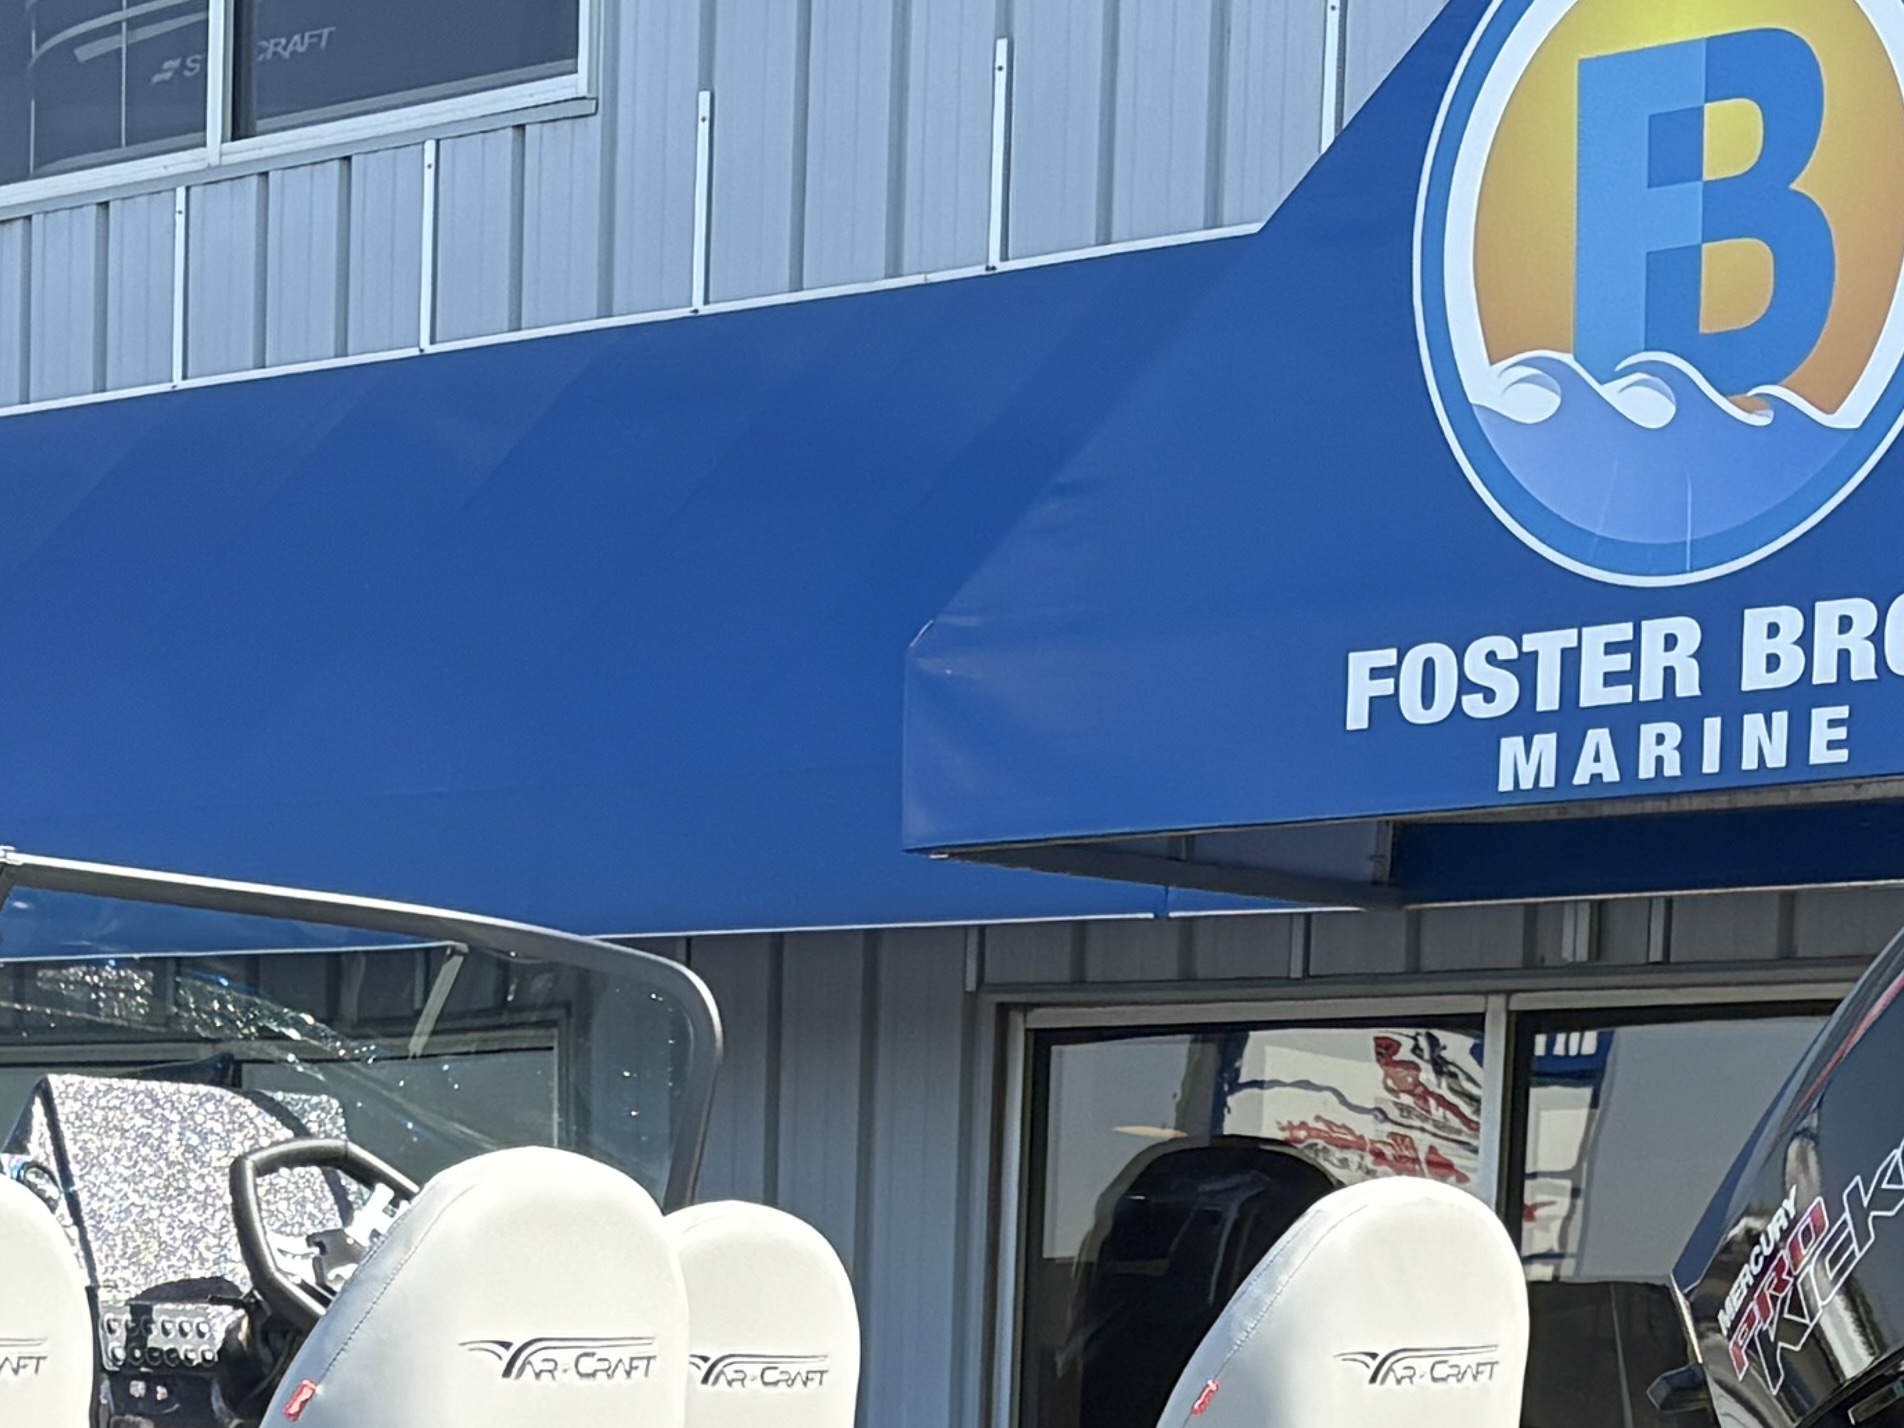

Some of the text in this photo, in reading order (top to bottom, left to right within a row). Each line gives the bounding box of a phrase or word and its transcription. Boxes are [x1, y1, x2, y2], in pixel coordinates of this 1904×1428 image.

[1344, 616, 1702, 731] FOSTER
[1498, 705, 1850, 792] MARINE
[1717, 1184, 1797, 1337] MERCURY
[1728, 1196, 1830, 1381] PRO
